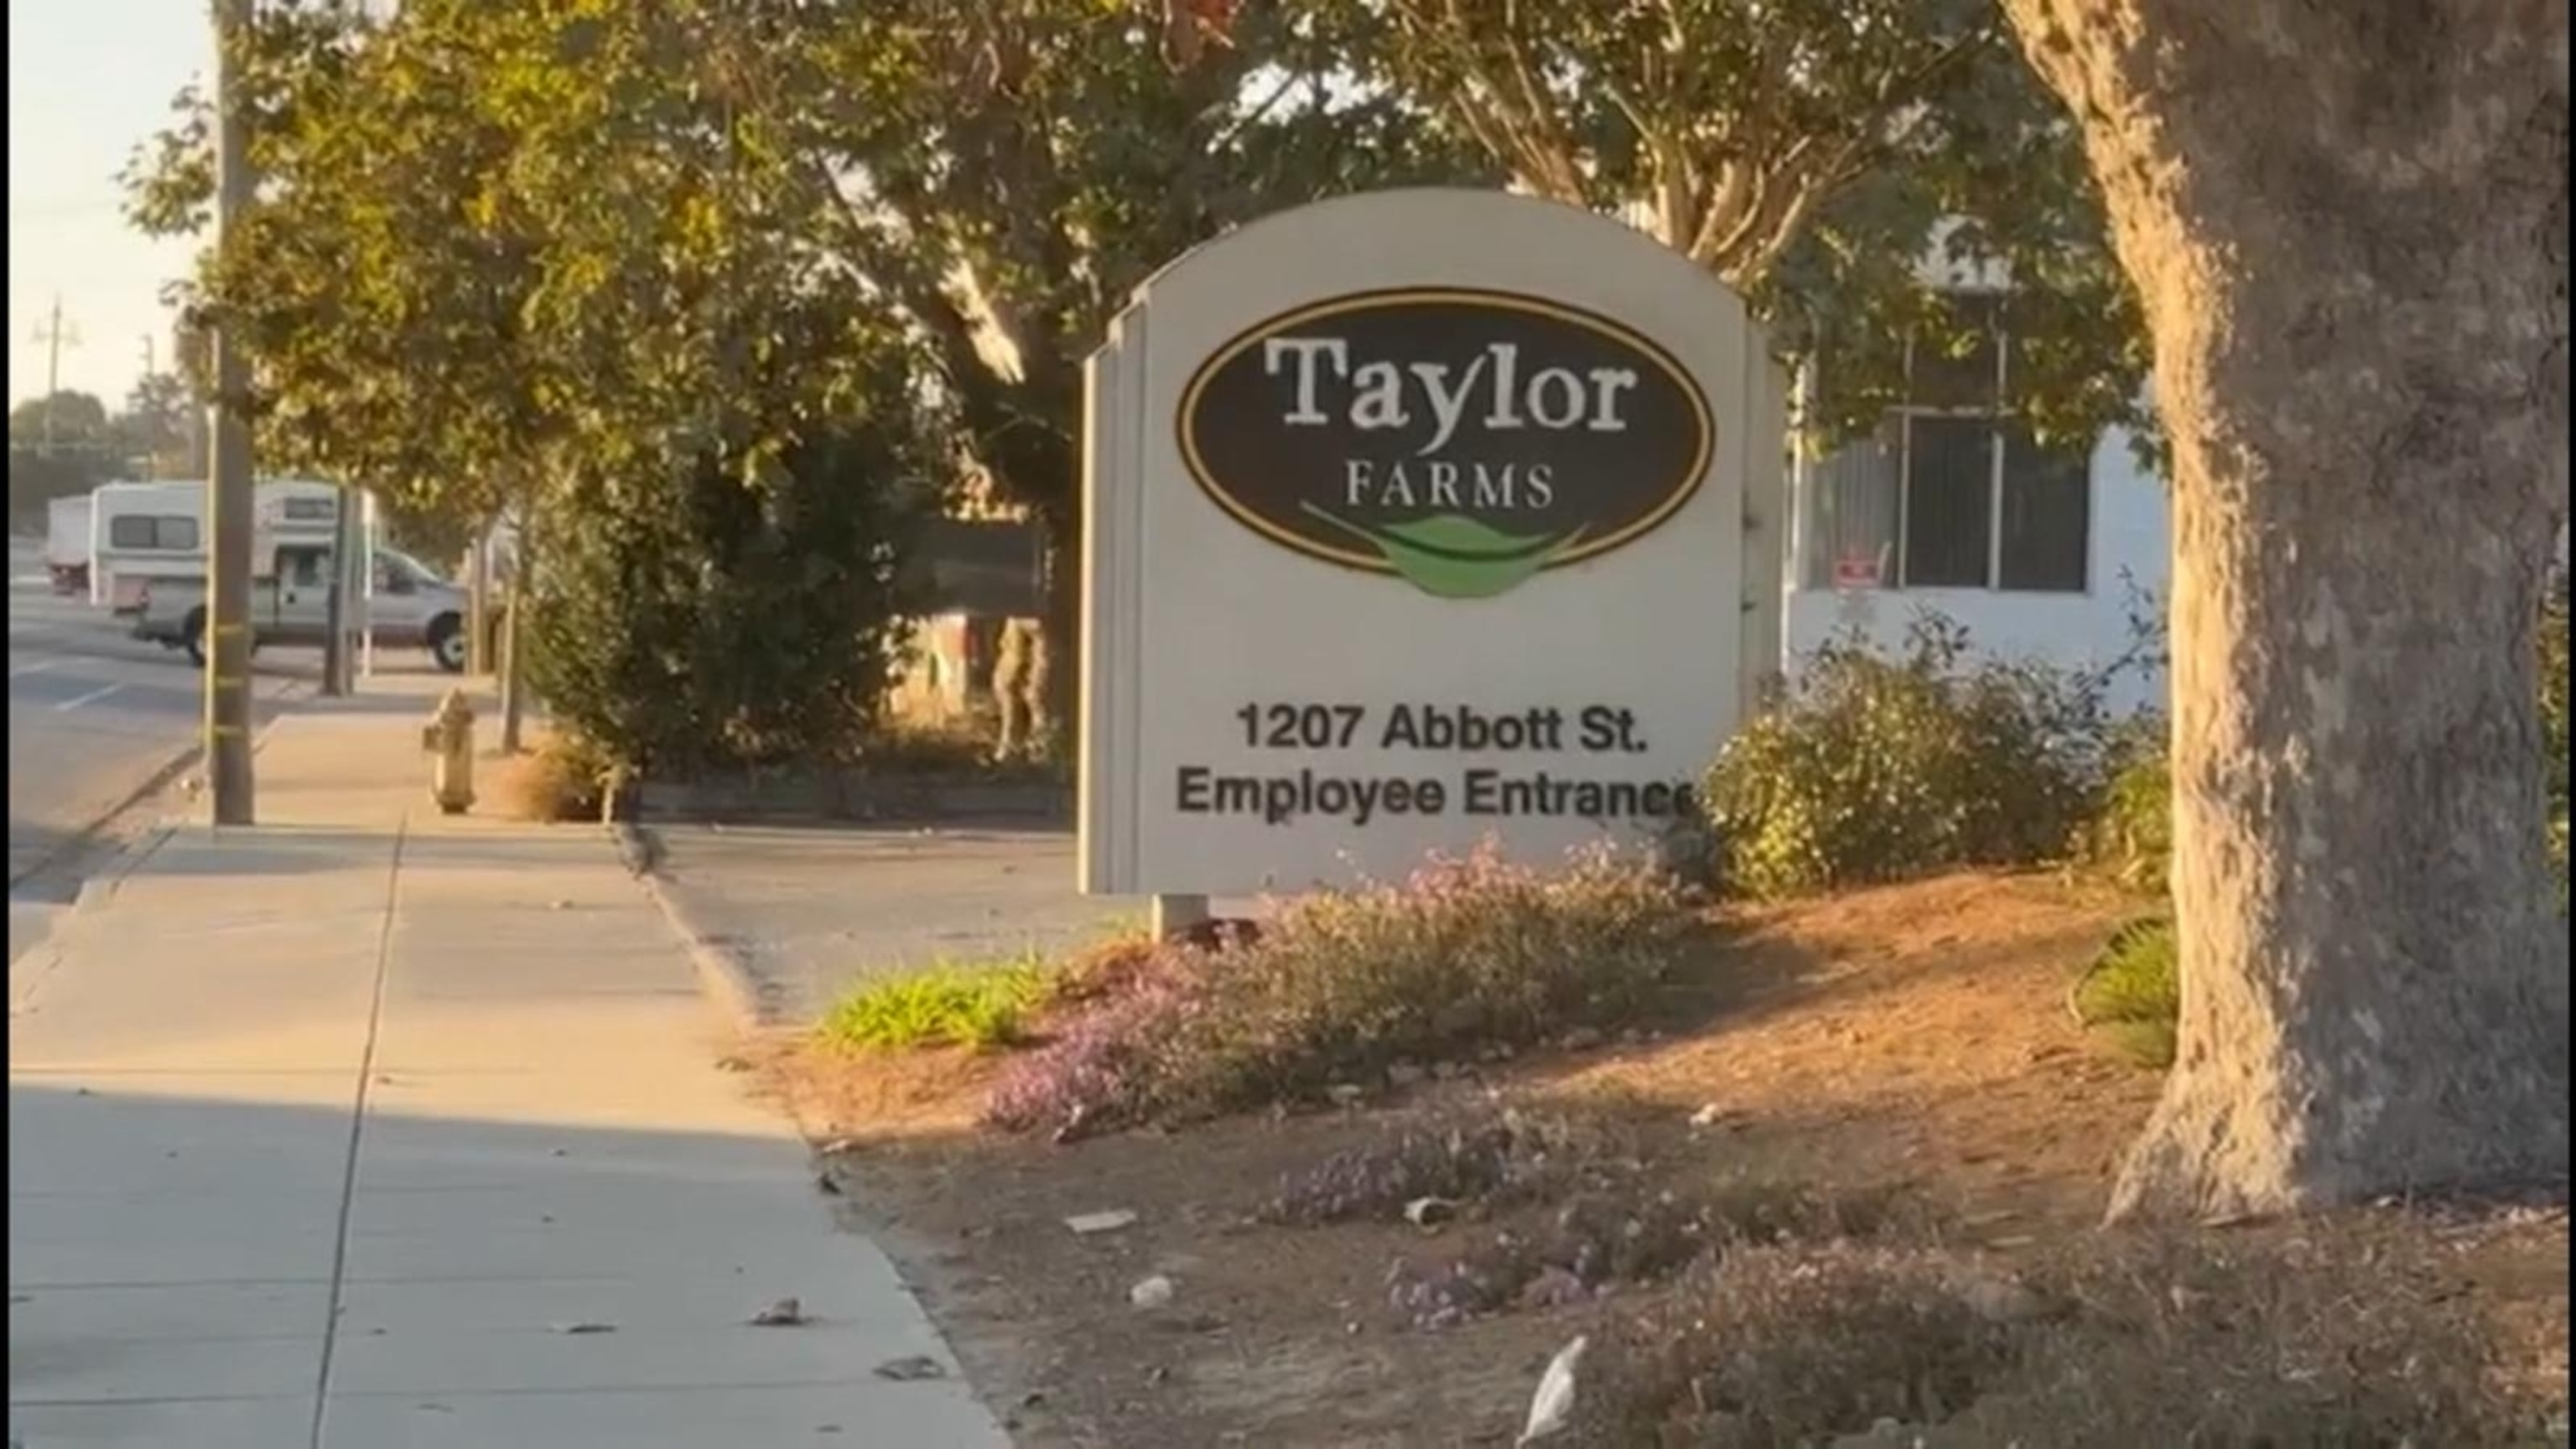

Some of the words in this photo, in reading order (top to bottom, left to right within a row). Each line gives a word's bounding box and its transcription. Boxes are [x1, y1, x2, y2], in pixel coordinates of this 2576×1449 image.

[1265, 338, 1638, 457] Taylor
[1346, 460, 1554, 509] FARMS
[1237, 704, 1364, 748] 1207
[1380, 704, 1562, 750] Abbott
[1579, 705, 1648, 752] St.
[1176, 766, 1445, 826] Employee
